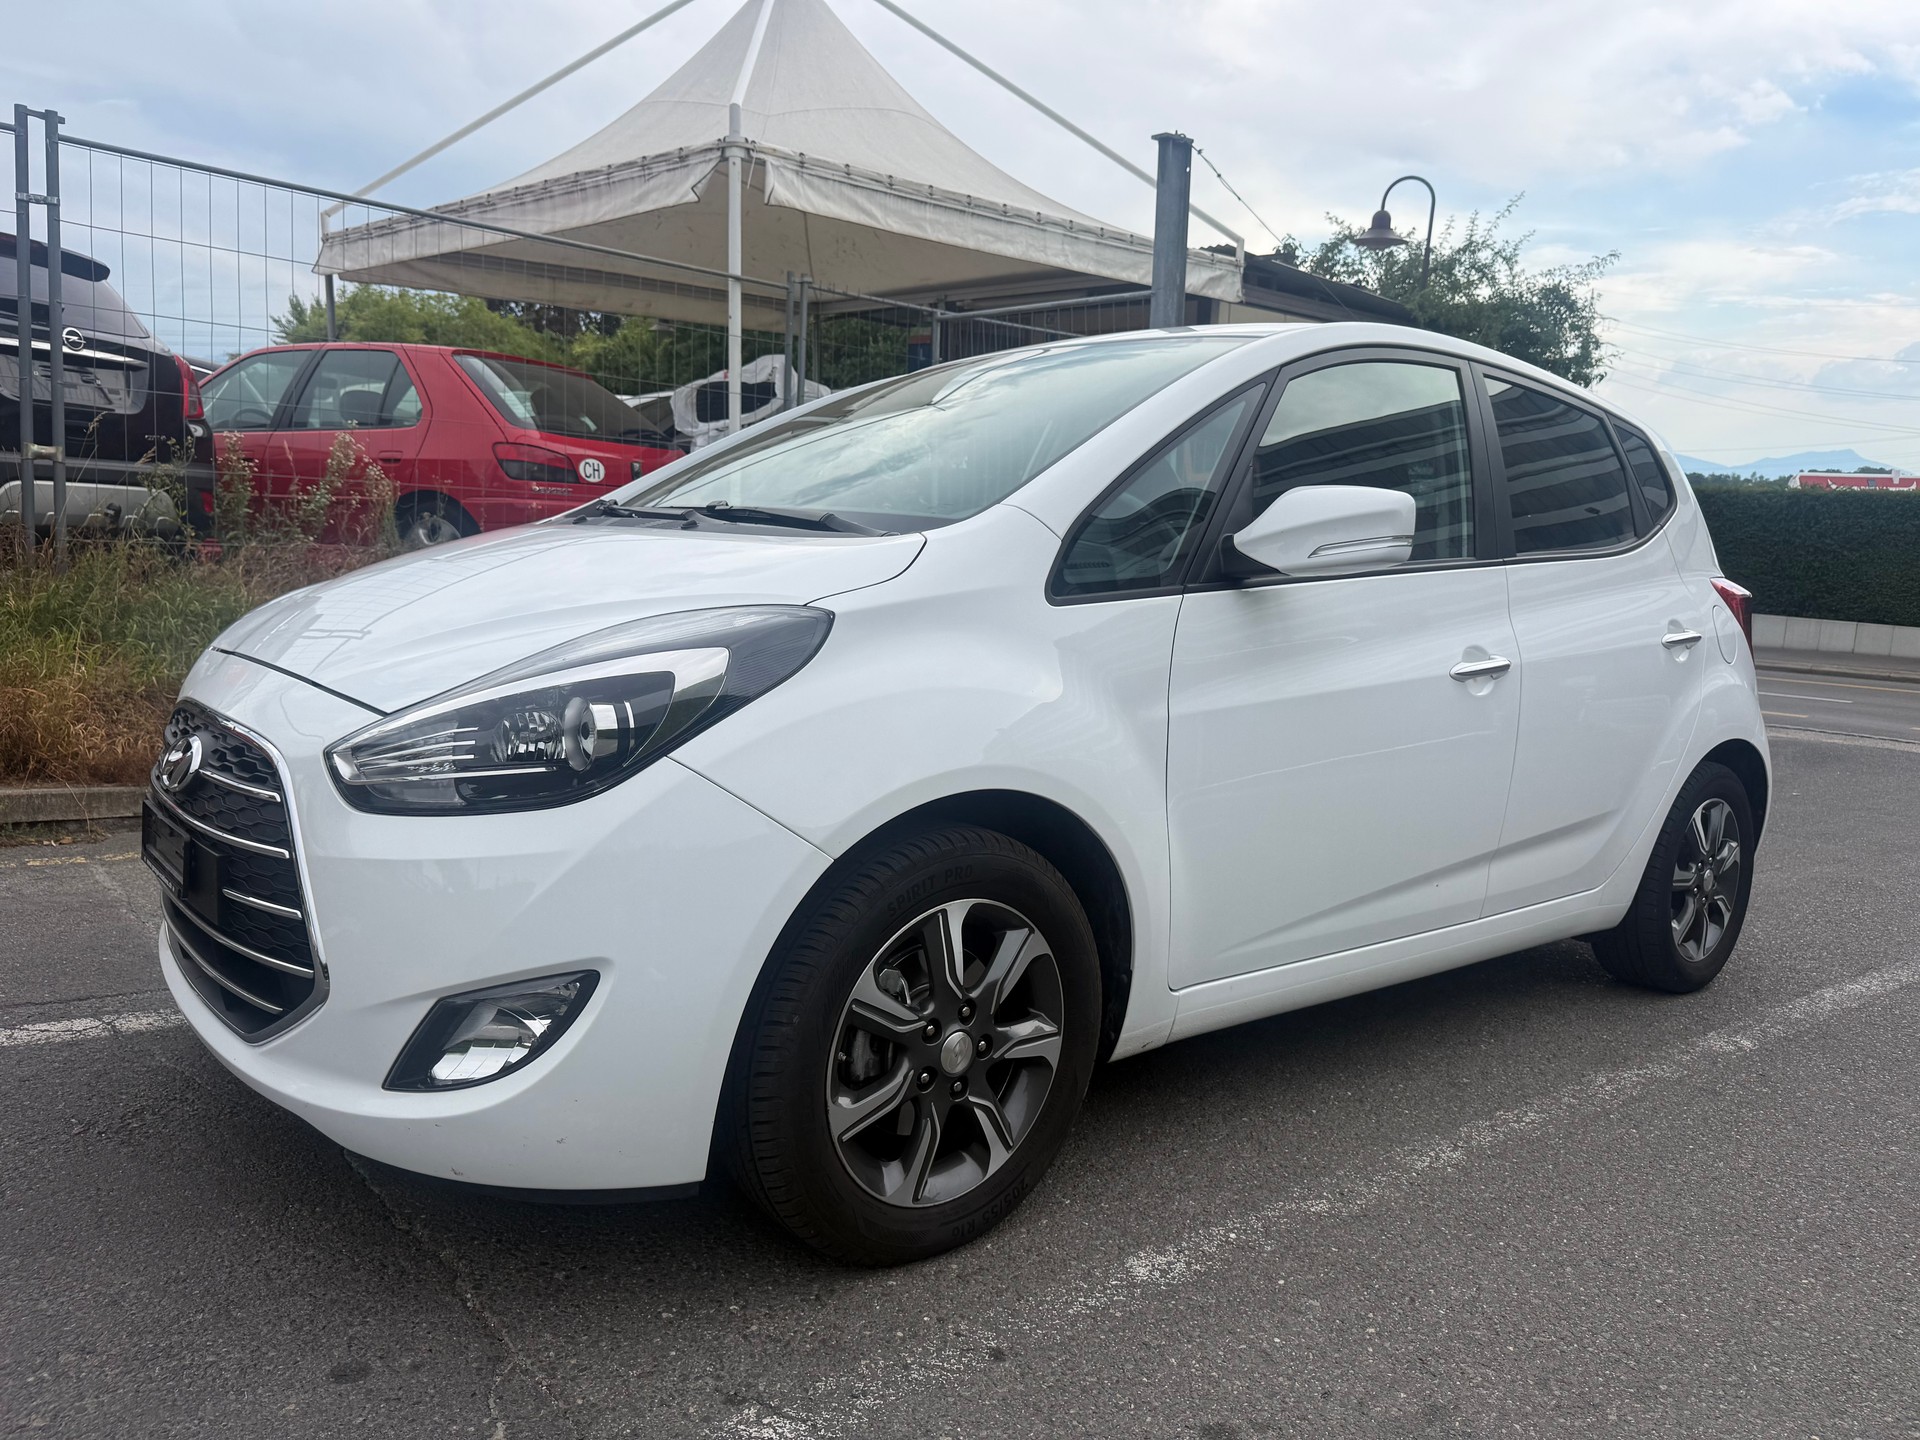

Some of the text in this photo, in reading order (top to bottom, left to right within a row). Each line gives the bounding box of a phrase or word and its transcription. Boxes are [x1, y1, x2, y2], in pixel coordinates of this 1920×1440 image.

[583, 461, 601, 480] CH
[887, 864, 973, 917] SPIRIT PRO
